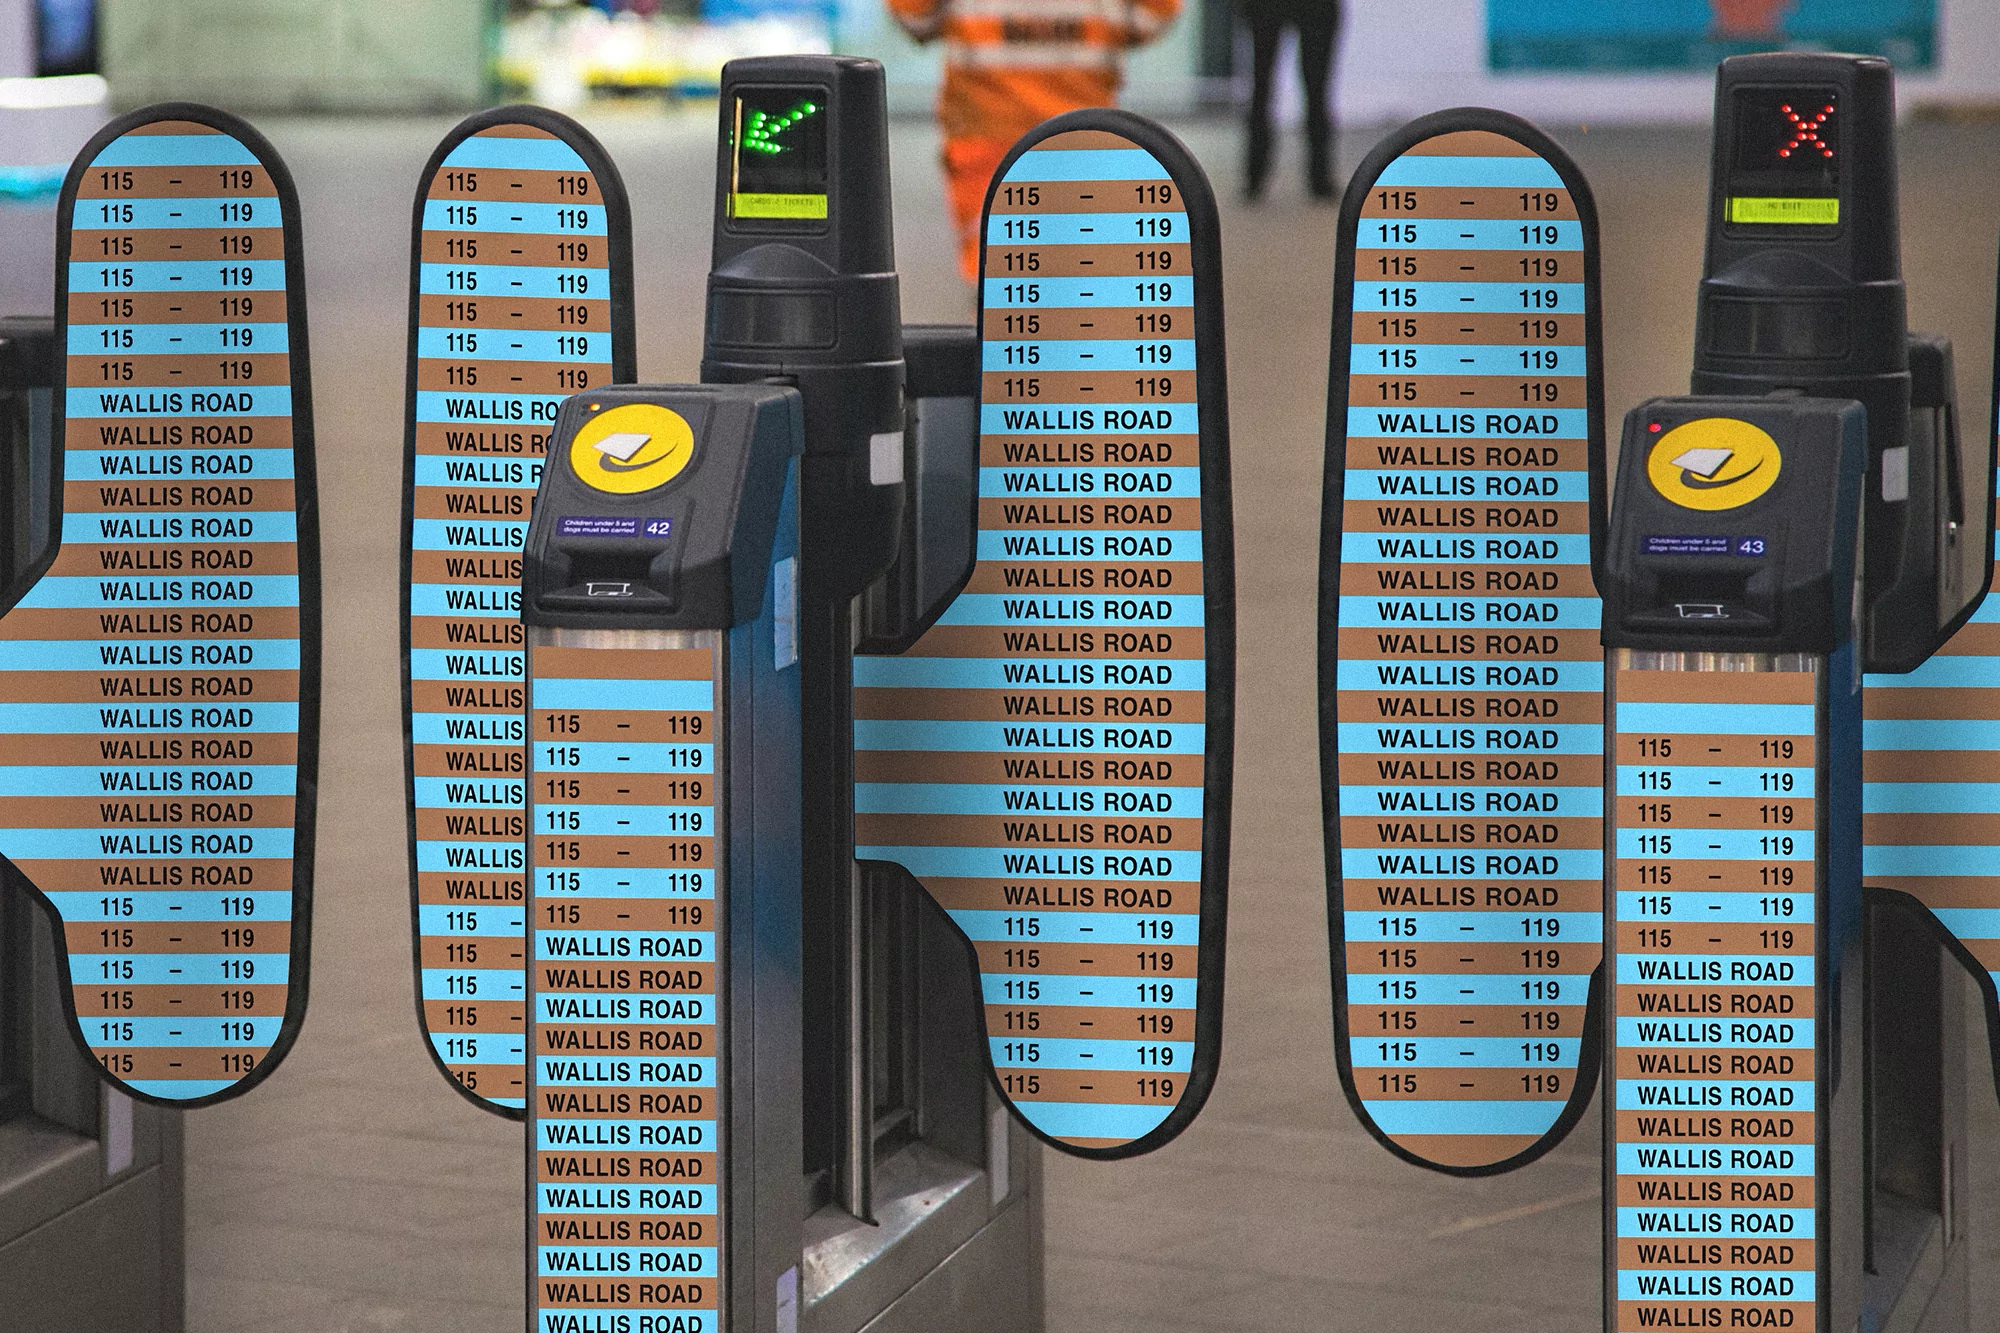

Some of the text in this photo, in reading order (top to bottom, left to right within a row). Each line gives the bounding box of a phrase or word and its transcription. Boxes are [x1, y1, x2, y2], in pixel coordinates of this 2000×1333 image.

[100, 169, 253, 191] 115 119
[446, 172, 588, 196] 115 119
[446, 205, 588, 229] 115 119
[1004, 218, 1172, 239] 115 119
[1378, 224, 1558, 245] 115 119
[100, 235, 253, 256] 115 119
[446, 270, 588, 294] 115 119
[1004, 282, 1172, 303] 115 119
[100, 297, 253, 318] 115 119
[1378, 288, 1558, 309] 115 119
[446, 332, 588, 356] 115 119
[100, 360, 253, 381] 115 119
[1003, 377, 1172, 398] 115 119
[1378, 381, 1559, 403] 115 119
[99, 393, 253, 413] WALLIS ROAD
[445, 398, 559, 421] WALLIS RO
[1003, 410, 1172, 430] WALLIS ROAD
[1377, 413, 1559, 434] WALLIS ROAD
[99, 454, 253, 475] WALLIS ROAD
[445, 461, 523, 483] WALLIS
[1003, 504, 1172, 525] WALLIS ROAD
[1376, 507, 1559, 528] WALLIS ROAD
[99, 518, 253, 538] WALLIS ROAD
[445, 526, 523, 547] WALLIS
[647, 522, 670, 535] 42
[1740, 540, 1764, 553] 43
[445, 558, 523, 579] WALLIS
[1003, 567, 1172, 589] WALLIS ROAD
[1377, 570, 1559, 591] WALLIS ROAD
[99, 613, 253, 634] WALLIS ROAD
[445, 655, 523, 676] WALLIS
[1003, 664, 1172, 685] WALLIS ROAD
[1377, 666, 1559, 686] WALLIS ROAD
[99, 708, 253, 728] WALLIS ROAD
[546, 714, 702, 735] 115 119
[445, 719, 523, 741] WALLIS
[1638, 738, 1794, 759] 115 119
[1003, 759, 1172, 781] WALLIS ROAD
[1377, 760, 1559, 781] WALLIS ROAD
[445, 783, 523, 805] WALLIS
[546, 779, 702, 801] 115 119
[99, 802, 253, 823] WALLIS ROAD
[1638, 803, 1794, 824] 115 119
[445, 848, 523, 869] WALLIS
[546, 841, 702, 862] 115 119
[1003, 854, 1172, 876] WALLIS ROAD
[1377, 855, 1559, 875] WALLIS ROAD
[1638, 865, 1794, 886] 115 119
[100, 897, 255, 917] 115 119
[446, 911, 477, 931] 115
[1004, 917, 1173, 940] 115 119
[1378, 917, 1560, 937] 115 119
[545, 936, 702, 957] WALLIS ROAD
[1637, 961, 1794, 981] WALLIS ROAD
[446, 975, 477, 995] 115
[1004, 980, 1173, 1003] 115 119
[1378, 980, 1560, 1000] 115 119
[100, 990, 255, 1010] 115 119
[545, 998, 702, 1019] WALLIS ROAD
[1637, 1022, 1794, 1043] WALLIS ROAD
[446, 1038, 477, 1058] 115
[545, 1062, 703, 1082] WALLIS ROAD
[1003, 1074, 1174, 1098] 115 119
[1378, 1074, 1560, 1094] 115 119
[1637, 1086, 1794, 1106] WALLIS ROAD
[545, 1125, 702, 1145] WALLIS ROAD
[1637, 1149, 1794, 1169] WALLIS ROAD
[545, 1189, 702, 1209] WALLIS ROAD
[1637, 1213, 1794, 1233] WALLIS ROAD
[545, 1252, 702, 1272] WALLIS ROAD
[1637, 1276, 1794, 1296] WALLIS ROAD
